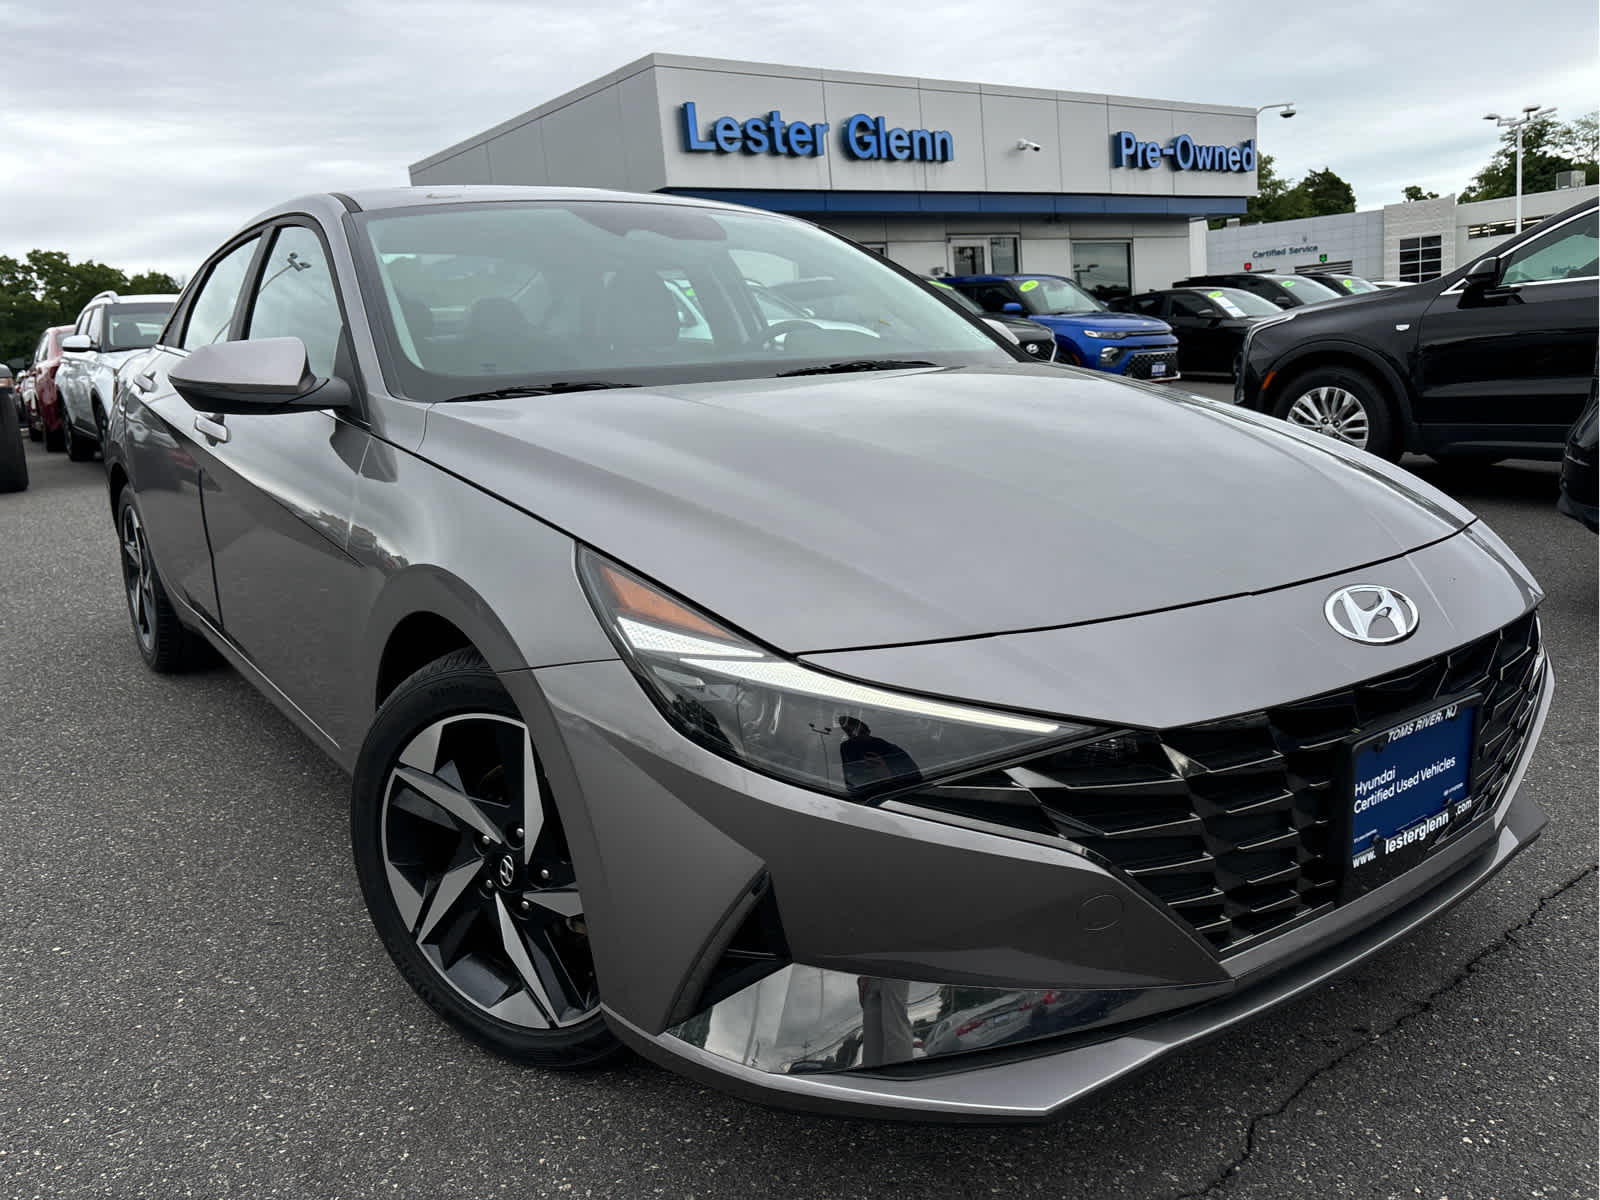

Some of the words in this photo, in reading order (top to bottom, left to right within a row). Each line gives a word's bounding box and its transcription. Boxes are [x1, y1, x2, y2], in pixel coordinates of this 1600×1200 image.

[681, 101, 829, 156] Lester
[845, 113, 954, 162] Glenn
[1114, 131, 1255, 172] Pre-Owned
[1252, 248, 1286, 259] Certified
[1289, 245, 1318, 255] Service
[1387, 723, 1414, 743] TOMS
[1445, 705, 1458, 719] NJ
[1353, 786, 1395, 814] Certified
[1396, 774, 1420, 793] Used
[1420, 756, 1456, 782] Vehicles
[1354, 765, 1396, 797] Hyundai
[1385, 812, 1449, 854] lesterglenn
